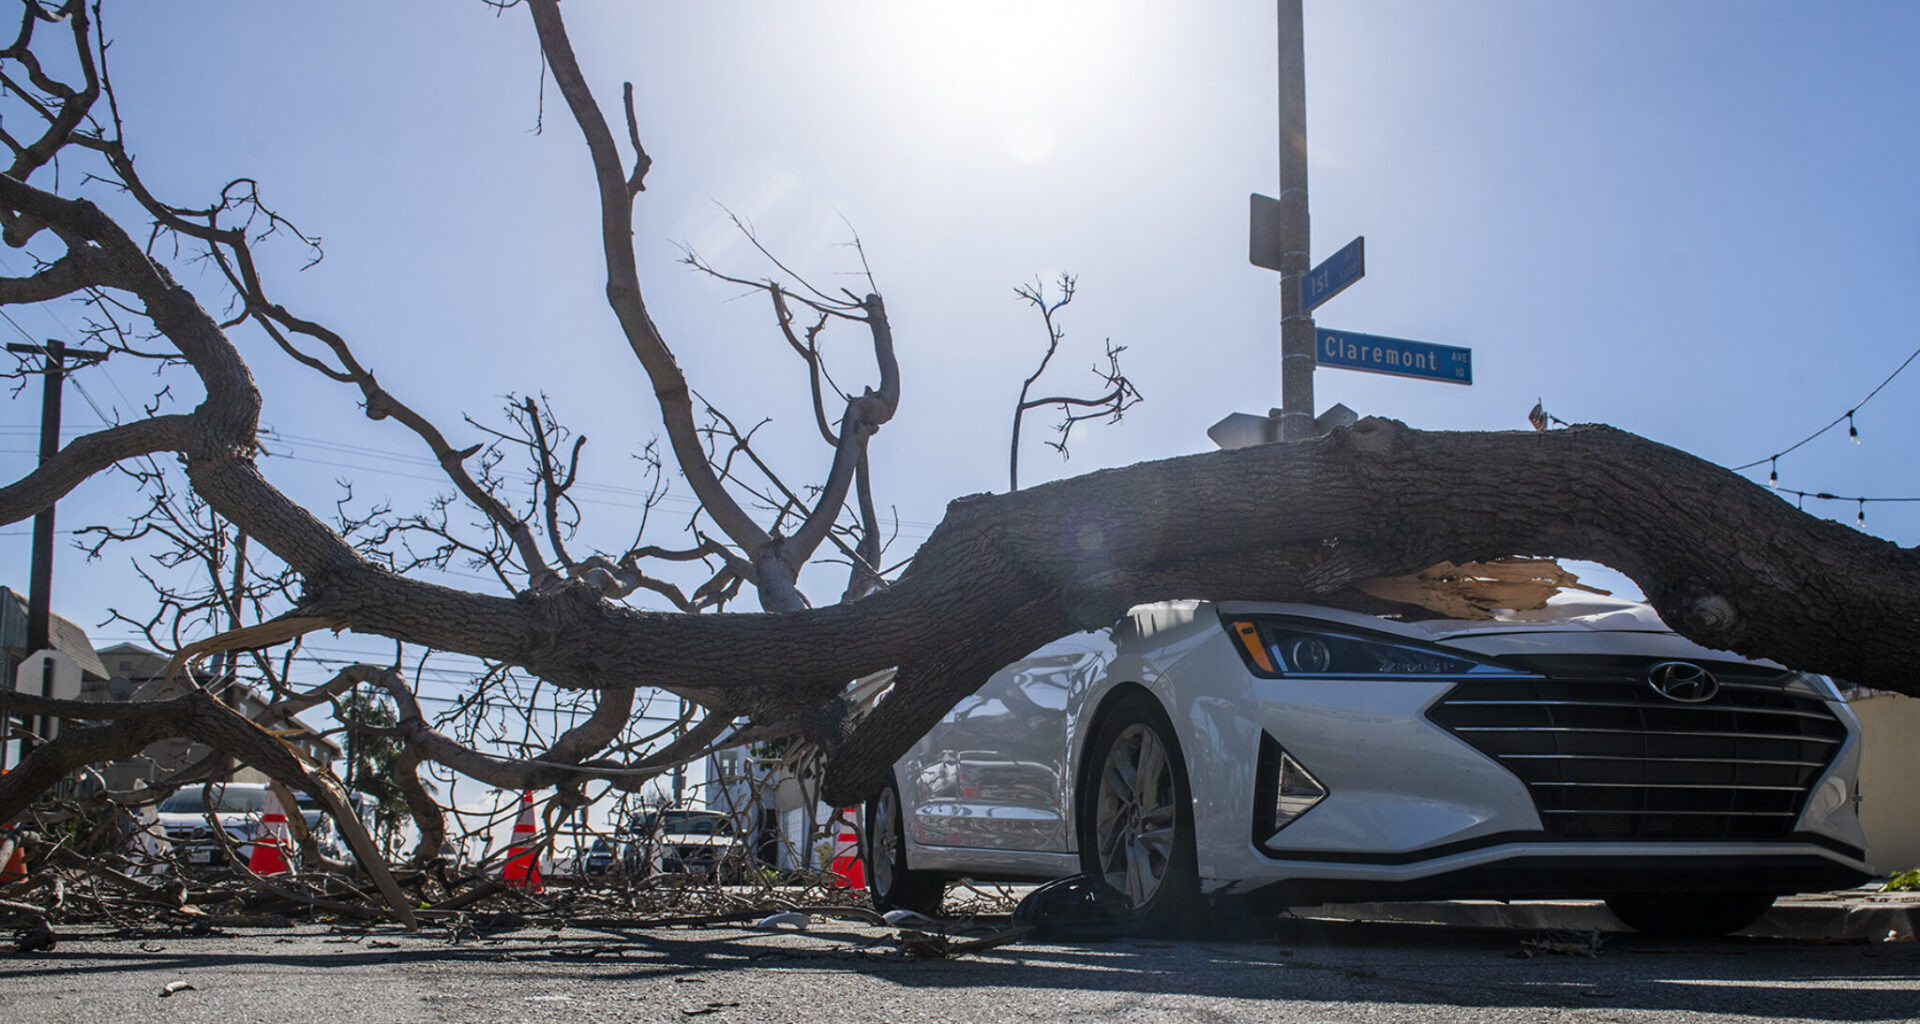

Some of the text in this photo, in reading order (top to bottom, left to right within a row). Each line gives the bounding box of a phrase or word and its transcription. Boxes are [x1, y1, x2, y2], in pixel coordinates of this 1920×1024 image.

[1312, 266, 1329, 297] 1st
[1325, 336, 1467, 371] Claremont AVE
